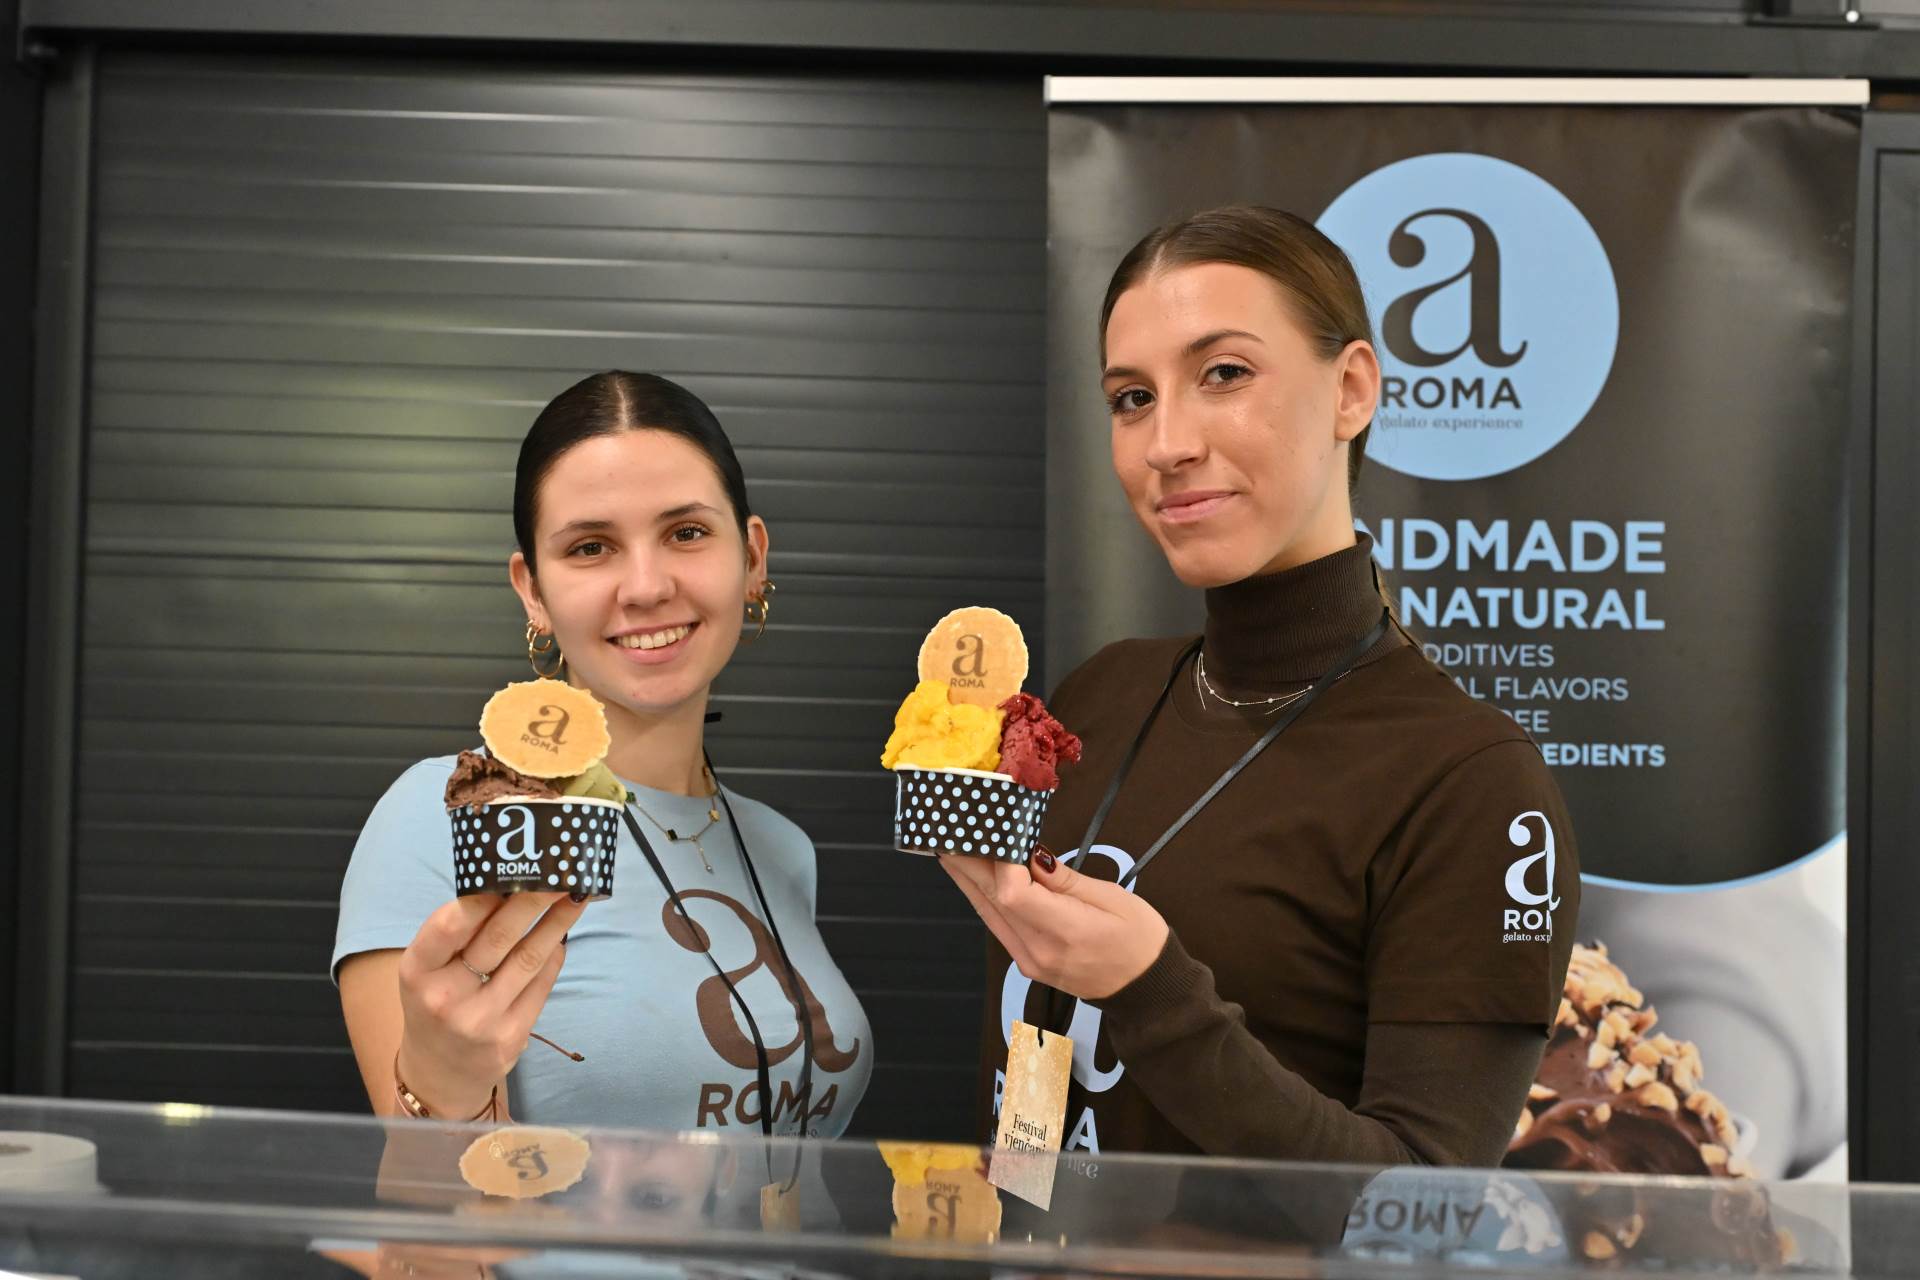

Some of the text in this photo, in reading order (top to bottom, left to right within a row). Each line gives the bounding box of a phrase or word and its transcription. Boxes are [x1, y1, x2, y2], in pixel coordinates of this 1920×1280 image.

[1380, 376, 1522, 410] ROMA
[1432, 414, 1524, 432] experience
[1401, 586, 1665, 630] NATURAL
[950, 678, 985, 689] ROMA
[1494, 677, 1630, 701] FLAVORS
[1503, 709, 1550, 732] EE
[520, 733, 559, 755] ROMA
[1538, 744, 1666, 767] EDIENTS
[497, 861, 541, 875] ROMA
[1502, 931, 1532, 944] gelato
[696, 1080, 839, 1128] ROMA
[1013, 1113, 1048, 1142] Festival
